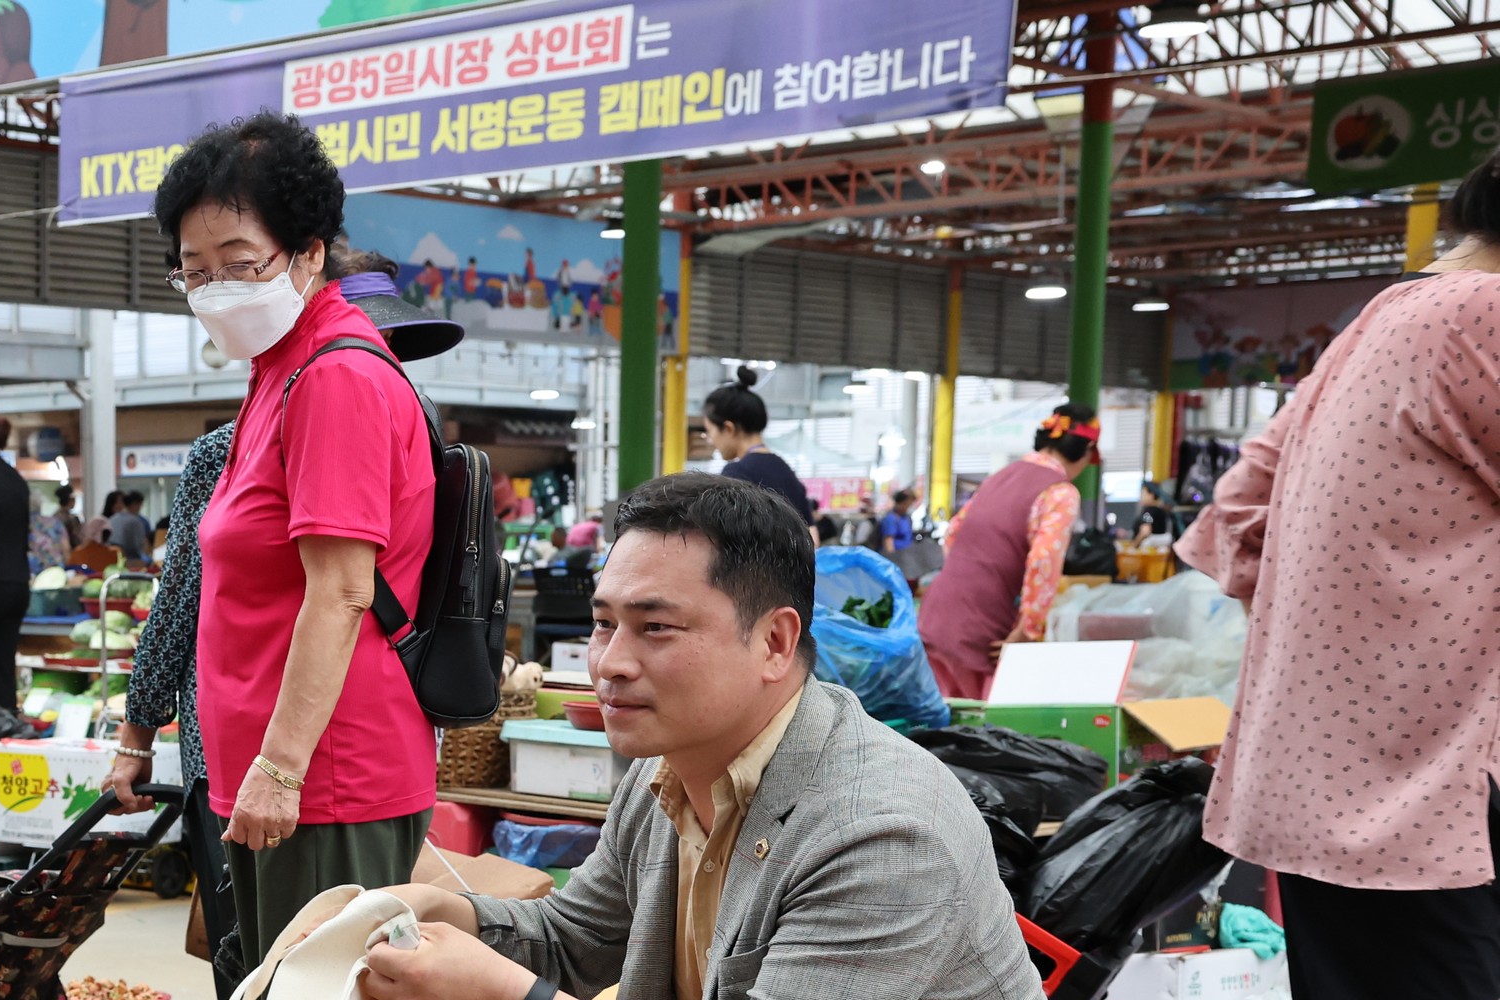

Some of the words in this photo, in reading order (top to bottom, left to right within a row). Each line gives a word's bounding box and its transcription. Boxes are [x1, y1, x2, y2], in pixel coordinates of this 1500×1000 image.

[291, 37, 494, 109] 광양5일시장
[505, 14, 672, 78] 상인회는
[430, 88, 586, 155] 서명운동
[598, 67, 763, 135] 캠페인에
[773, 35, 976, 111] 참여합니다
[0, 775, 60, 798] 청양고추
